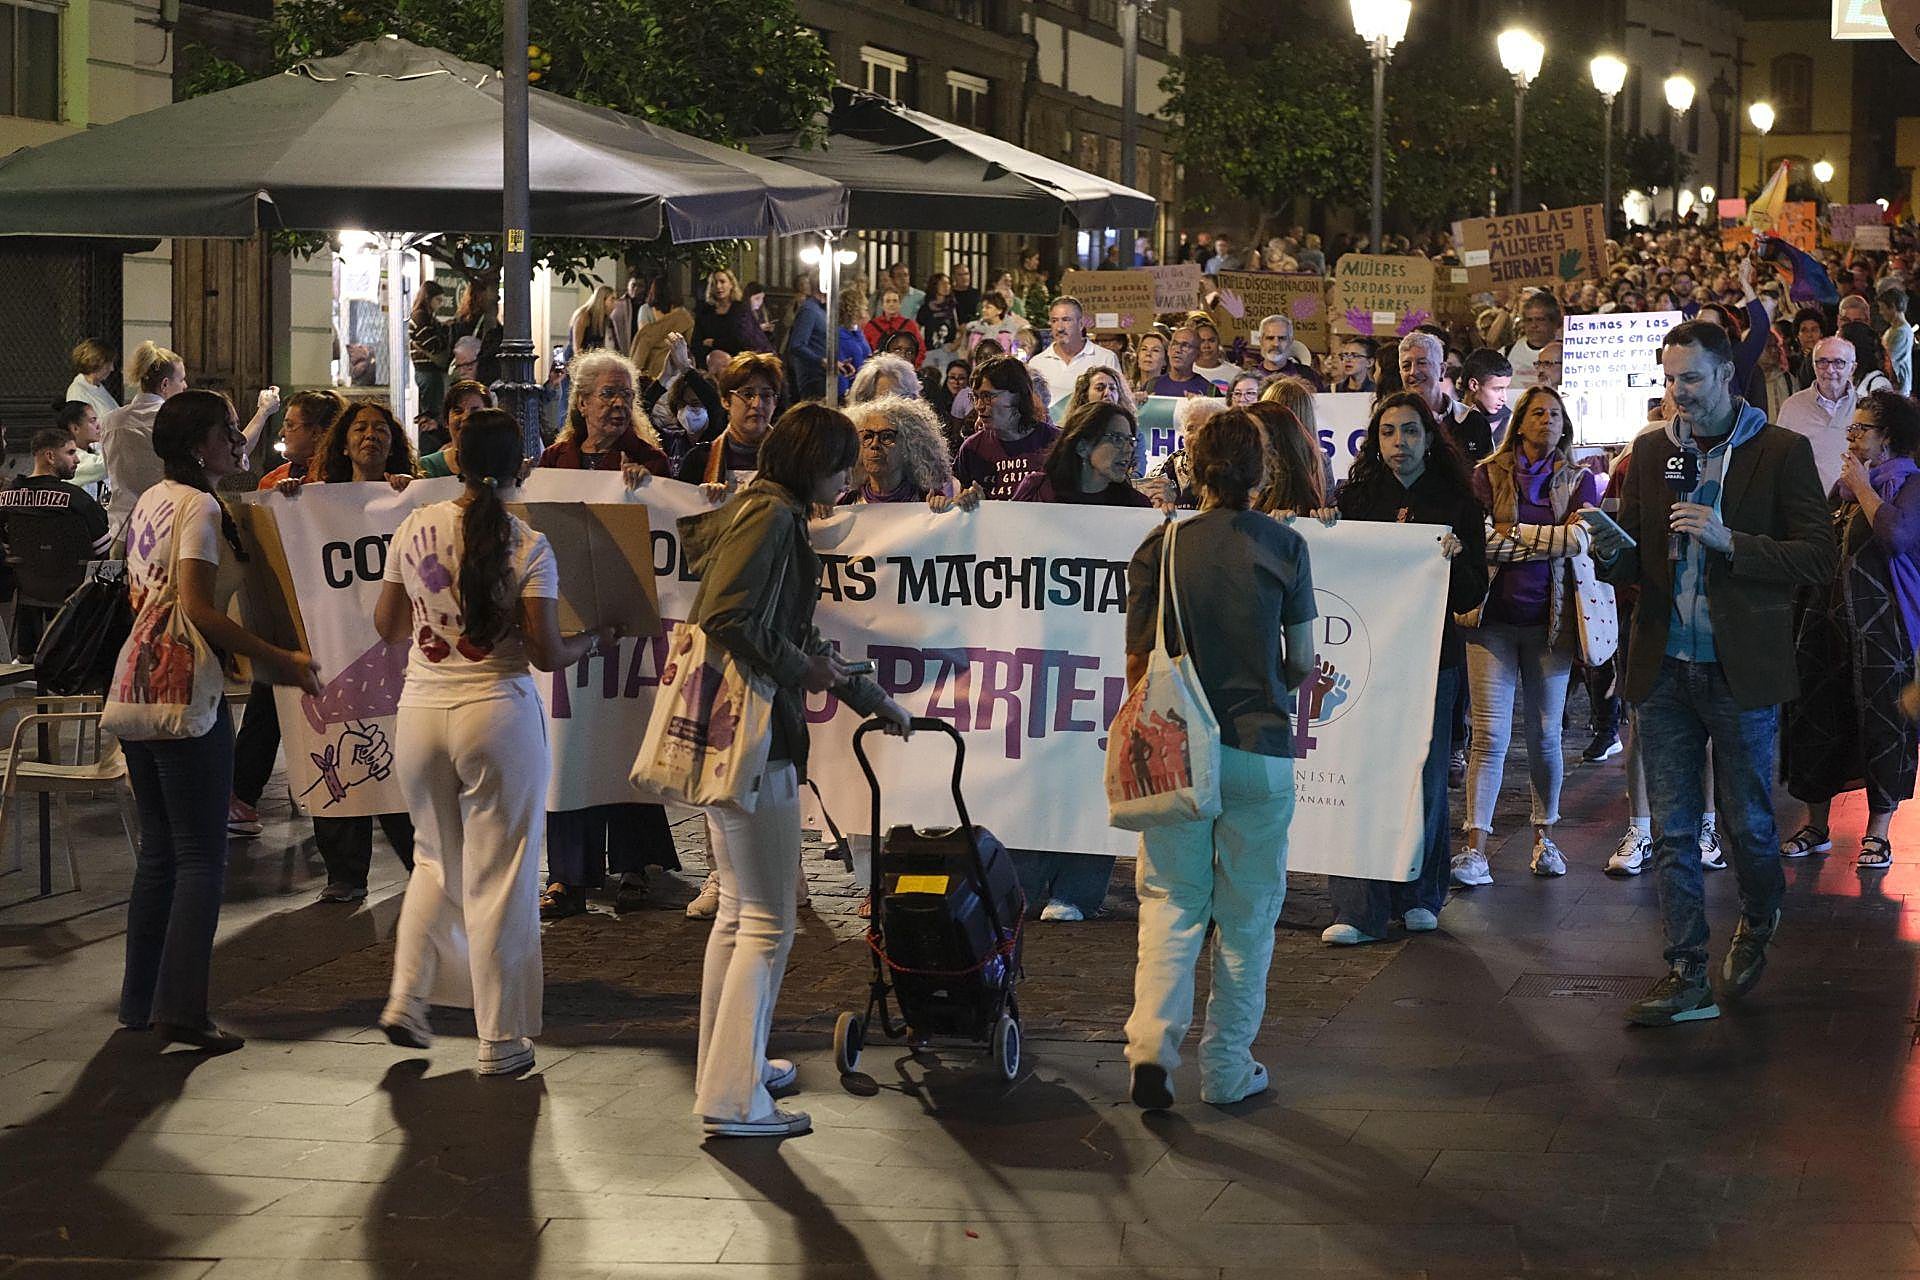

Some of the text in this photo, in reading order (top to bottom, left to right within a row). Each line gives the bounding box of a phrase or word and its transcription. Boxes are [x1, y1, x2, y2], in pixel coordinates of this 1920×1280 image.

[1486, 211, 1573, 239] 25N LAS
[1488, 233, 1567, 260] MUJERES
[1342, 259, 1406, 277] MUJERES
[1489, 256, 1554, 283] SORDAS
[1342, 281, 1391, 295] SORDAS
[1395, 284, 1426, 295] VIVAS
[1244, 293, 1287, 305] MUJERES
[1343, 297, 1355, 310] Y
[1564, 349, 1609, 360] mueren
[996, 458, 1028, 472] SOMOS
[991, 486, 1012, 496] LAS
[34, 490, 70, 508] IBIZA
